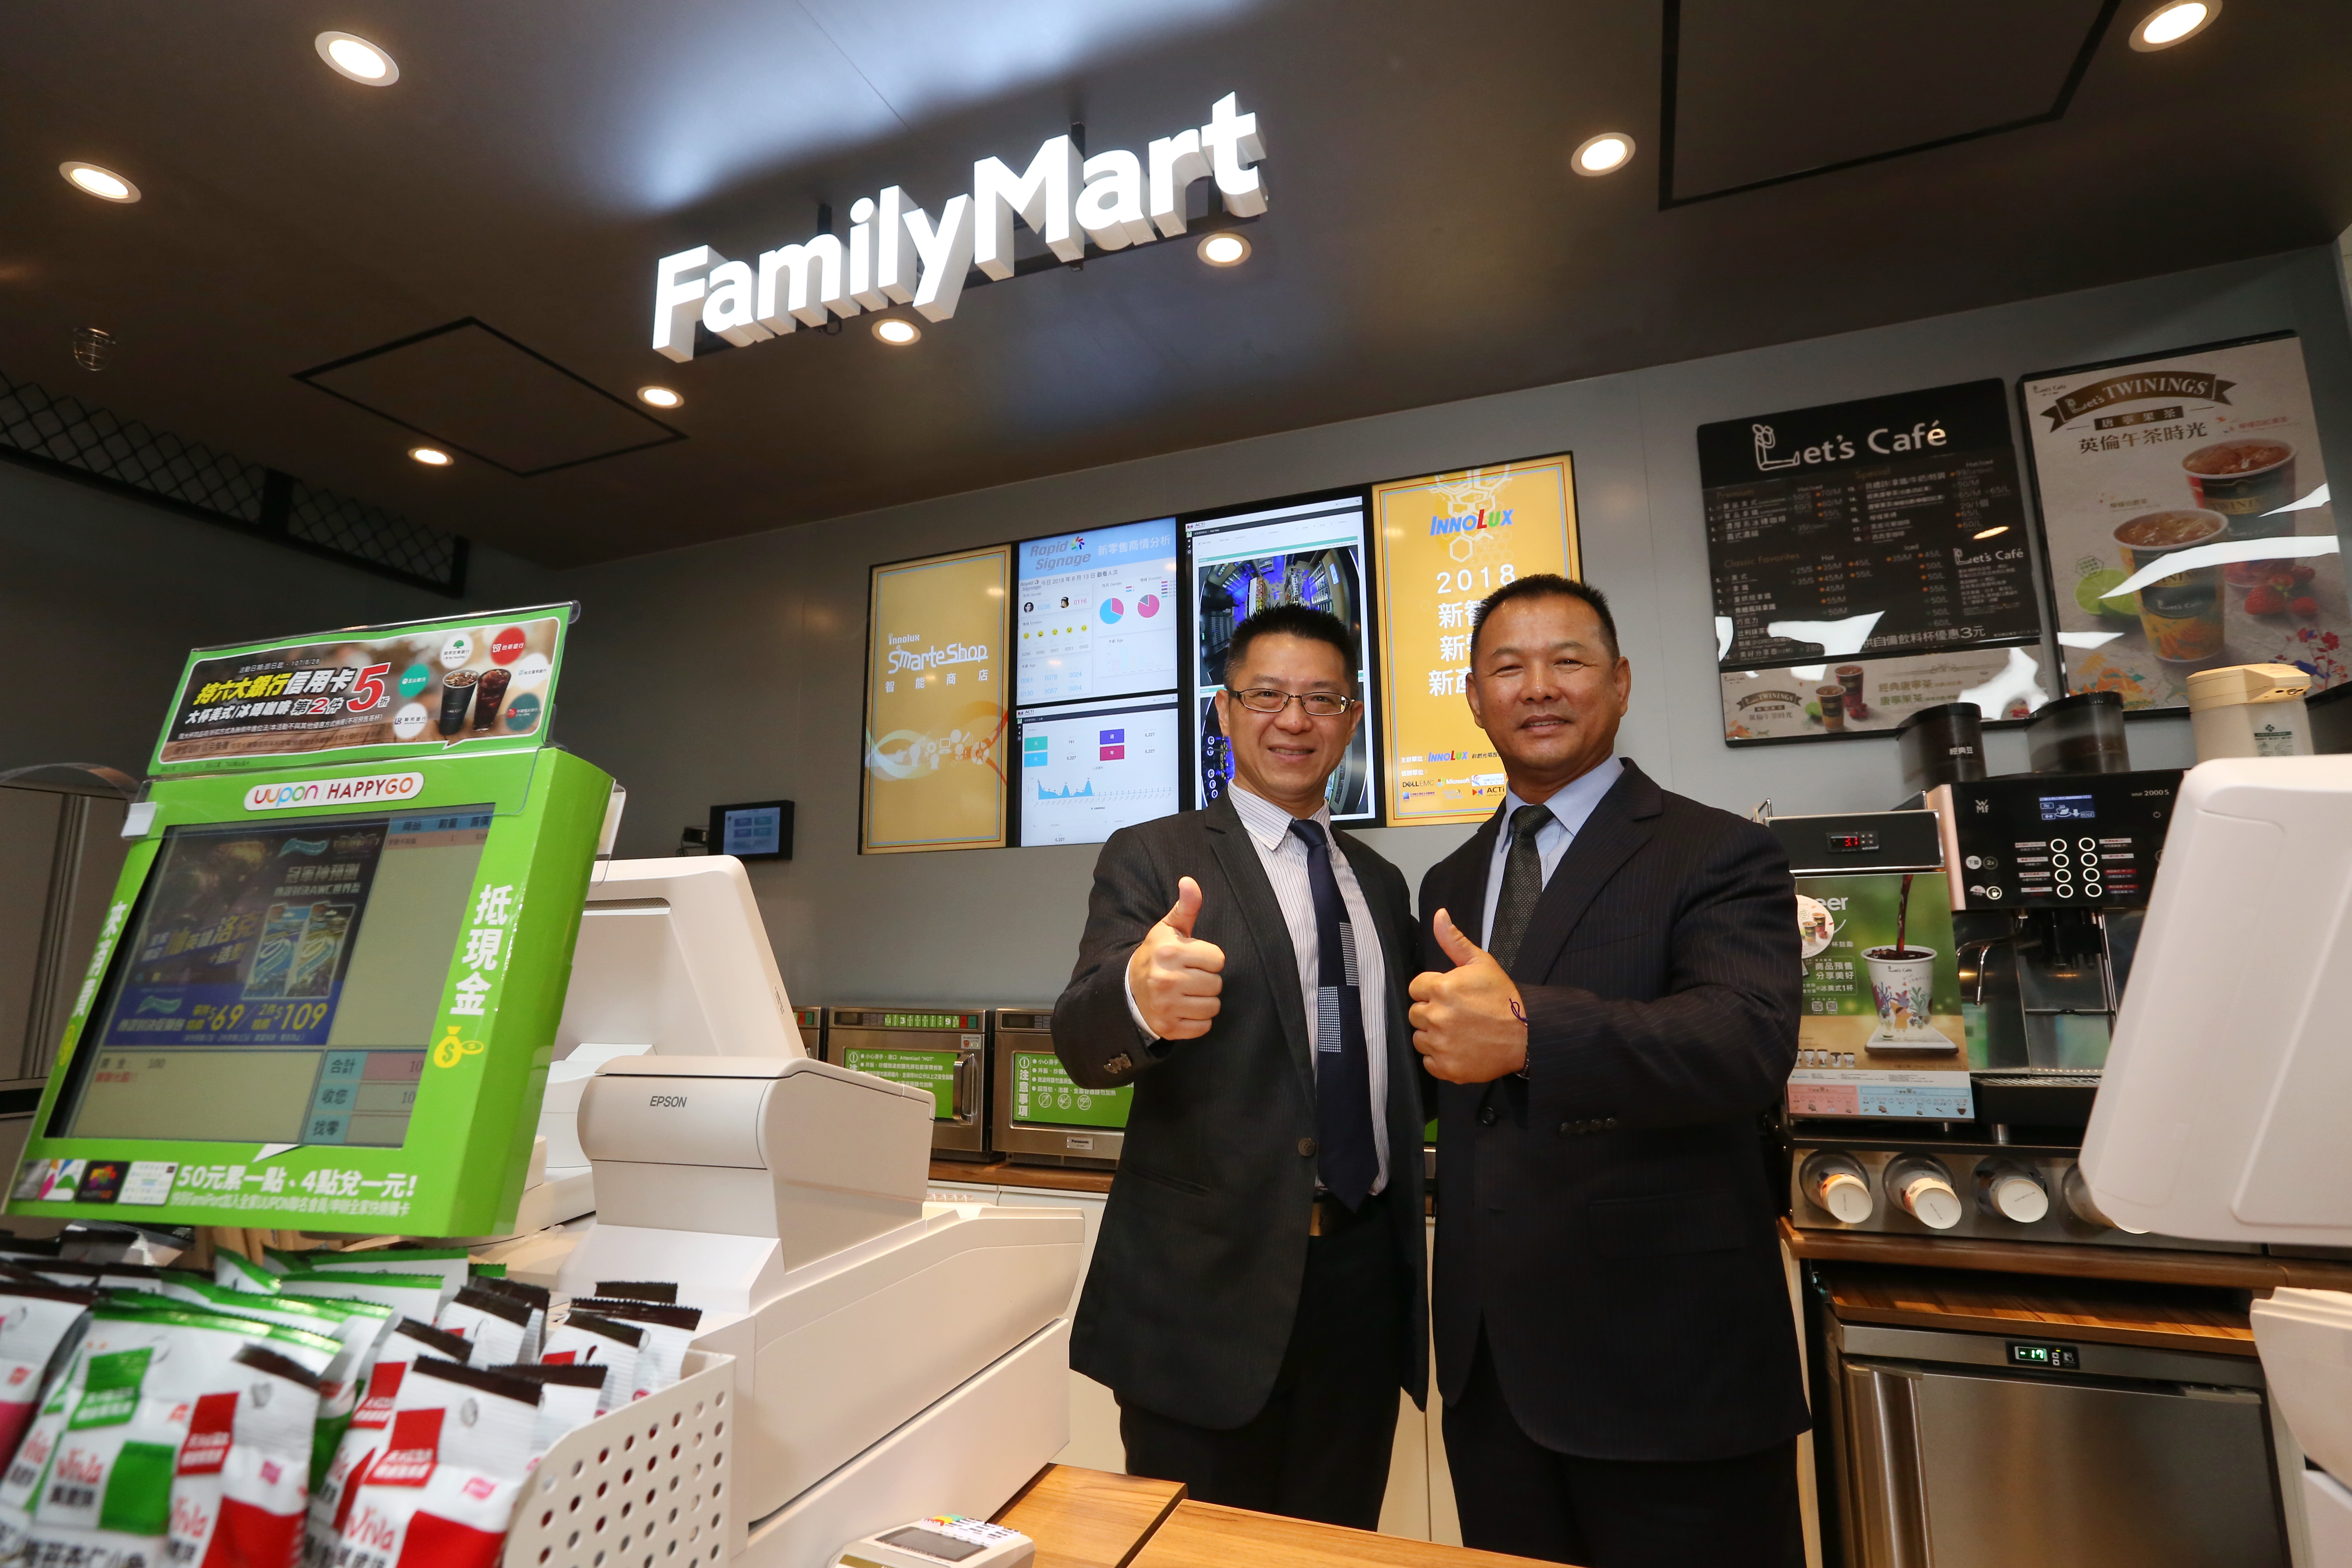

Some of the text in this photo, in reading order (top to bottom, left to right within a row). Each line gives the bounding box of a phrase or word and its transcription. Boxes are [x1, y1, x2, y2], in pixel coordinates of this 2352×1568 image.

[652, 91, 1268, 361] FamilyMart
[2103, 376, 2209, 402] TWININGS
[1867, 420, 1947, 455] Café
[2079, 422, 2208, 453] 英倫午茶時光
[1030, 541, 1068, 557] Rapid
[1098, 535, 1170, 556] 新零售商情分析
[1995, 548, 2024, 560] Café
[1036, 553, 1091, 570] Signage
[1436, 563, 1515, 594] 2018
[193, 667, 356, 705] 持六大銀行信用卡
[885, 669, 988, 693] 智能商店
[327, 777, 414, 800] HAPPYGO
[450, 884, 512, 1017] 抵現金
[1816, 971, 1854, 980] 分享美好
[650, 1096, 687, 1107] EPSON
